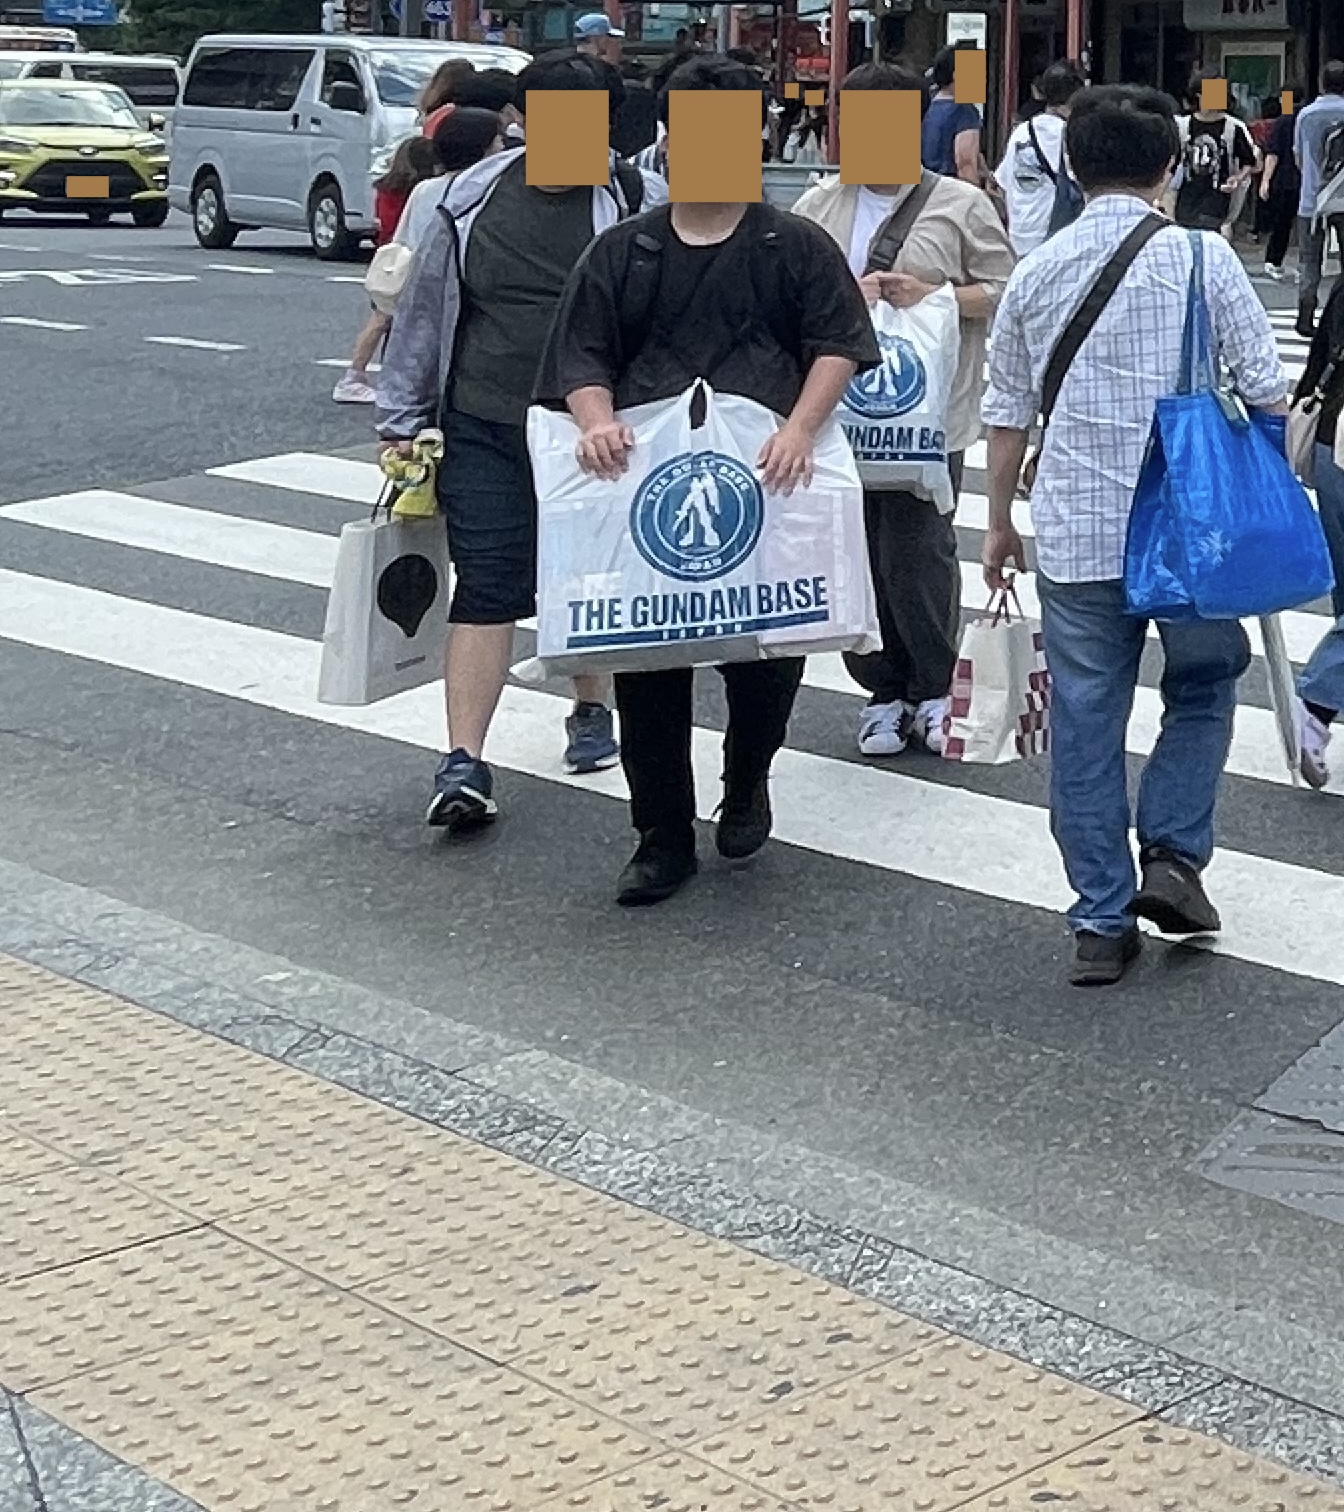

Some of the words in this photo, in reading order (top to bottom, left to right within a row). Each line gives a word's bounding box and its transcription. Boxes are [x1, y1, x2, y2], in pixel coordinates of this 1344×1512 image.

[567, 598, 622, 633] THE
[631, 584, 752, 629] GUNDAM
[757, 575, 829, 615] BASE
